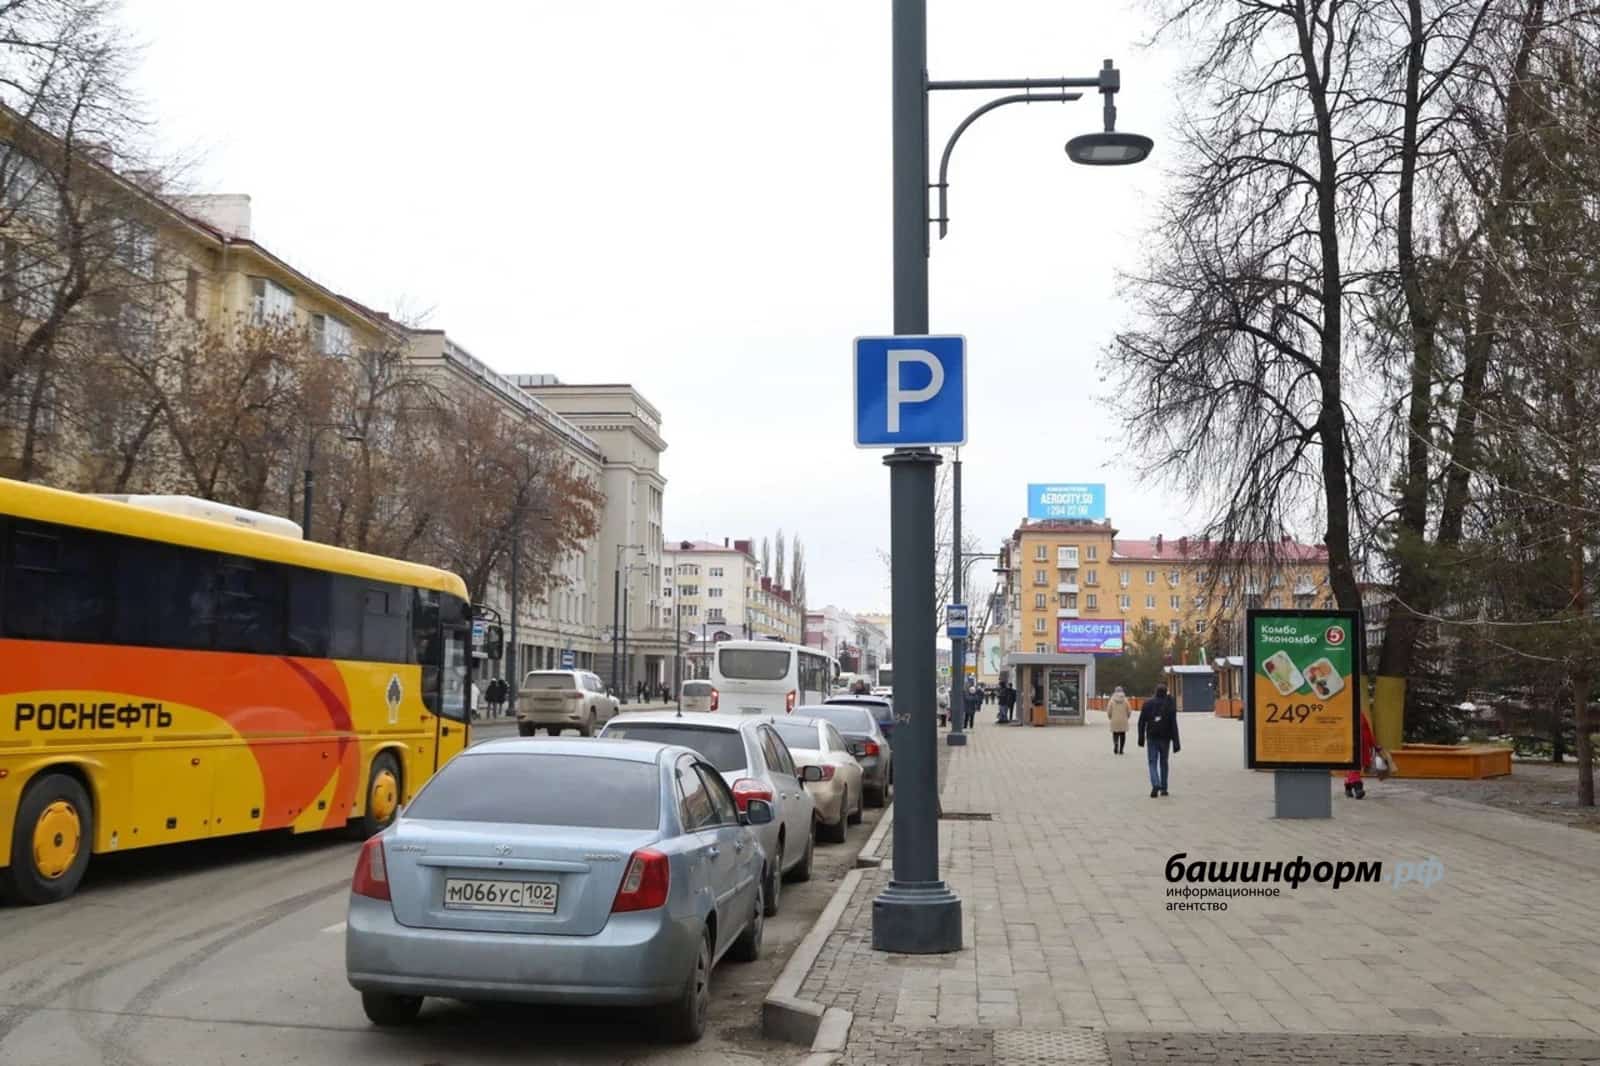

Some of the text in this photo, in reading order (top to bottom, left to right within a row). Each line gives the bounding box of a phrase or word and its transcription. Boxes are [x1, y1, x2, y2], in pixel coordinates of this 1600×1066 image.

[887, 349, 944, 433] P
[1060, 622, 1121, 635] Навсегда
[1261, 625, 1297, 634] Комбо
[1328, 628, 1341, 642] 5
[1261, 634, 1317, 644] Экономбо
[15, 702, 173, 731] РОСНЕФТЬ
[1265, 703, 1310, 724] 249
[1311, 703, 1324, 712] 99
[449, 883, 553, 904] М066УС 102
